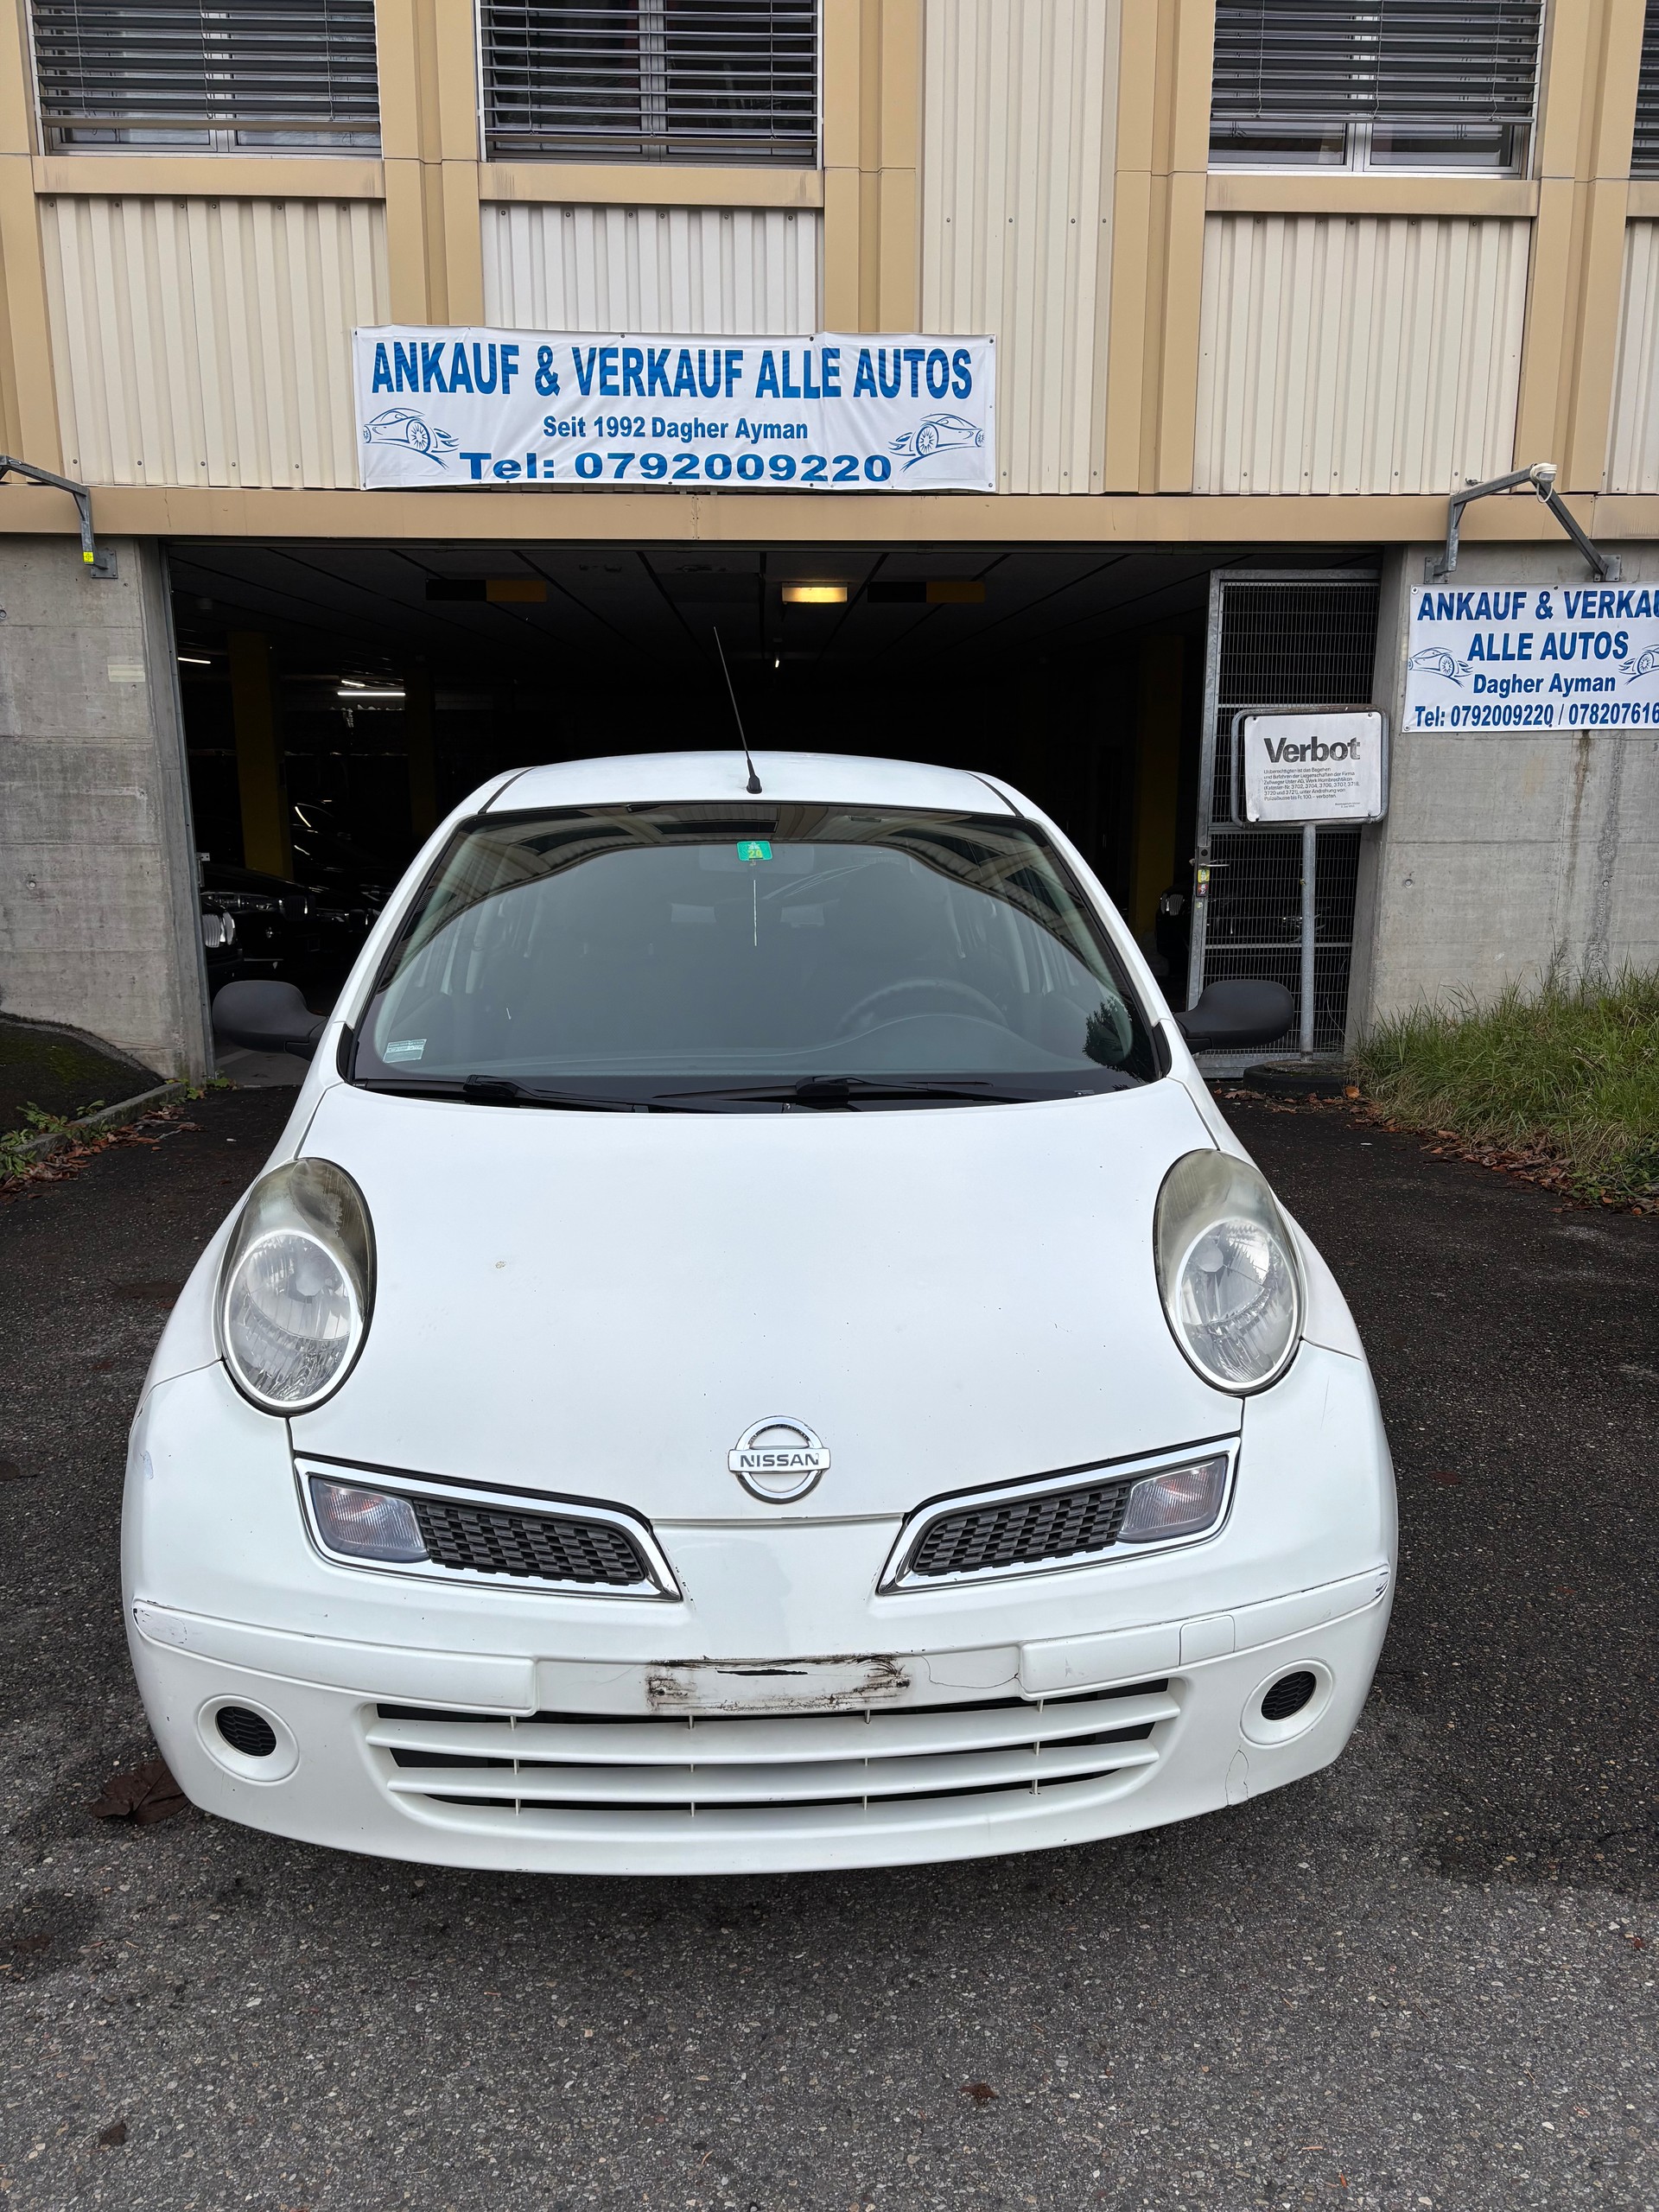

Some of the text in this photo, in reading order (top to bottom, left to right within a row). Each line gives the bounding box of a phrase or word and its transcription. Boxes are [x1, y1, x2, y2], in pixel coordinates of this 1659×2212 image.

[372, 341, 973, 399] ANKAUF & VERKAUF ALLE AUTOS
[543, 415, 808, 444] Seit 1992 Dagher Ayman
[460, 452, 892, 482] Tel: 0792009220
[1417, 589, 1659, 621] ANKAUF & VERKA
[1467, 631, 1630, 661] ALLE AUTOS
[1473, 672, 1616, 698] Dagher Ayman
[1414, 705, 1446, 728] Tel:
[1451, 703, 1554, 728] 0792009220
[1558, 703, 1565, 726] /
[1263, 736, 1361, 764] Verbot
[740, 1453, 819, 1468] NISSAN
